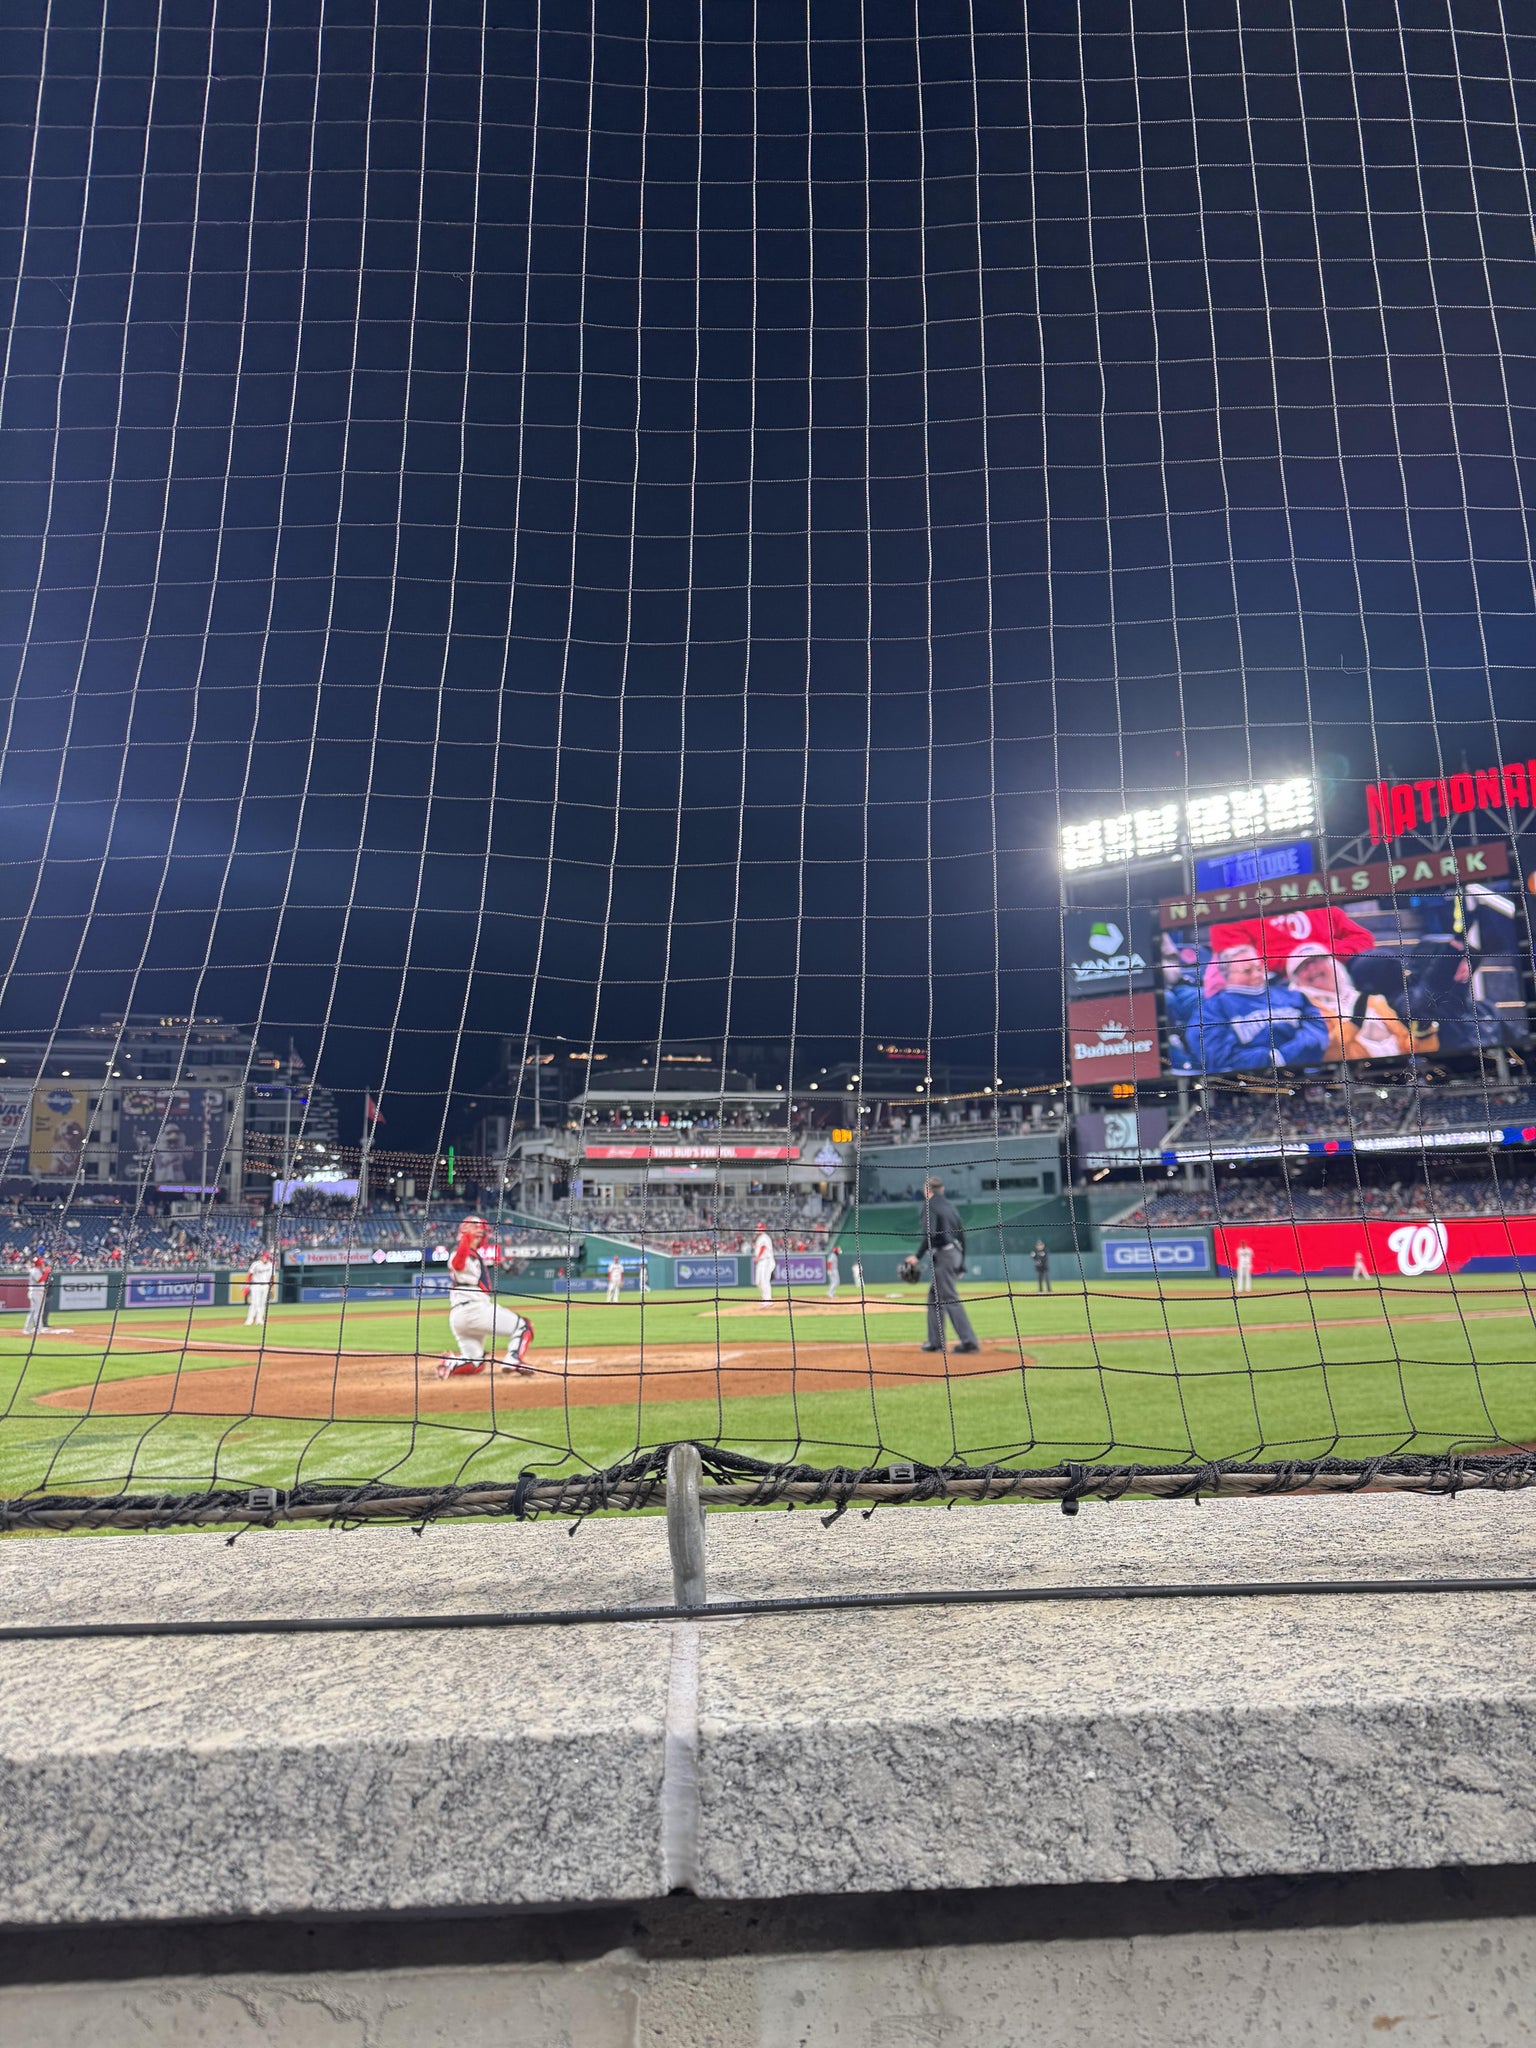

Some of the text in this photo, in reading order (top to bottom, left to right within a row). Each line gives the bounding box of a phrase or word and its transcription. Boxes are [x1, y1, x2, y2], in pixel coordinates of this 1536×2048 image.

[1169, 851, 1488, 921] NATIONALS PARK
[1074, 1039, 1153, 1060] Budweiser
[1114, 1246, 1195, 1265] GEICO
[693, 1267, 733, 1278] VANDA
[775, 1264, 824, 1280] leidos
[63, 1282, 105, 1293] GDIT
[157, 1281, 205, 1295] inova
